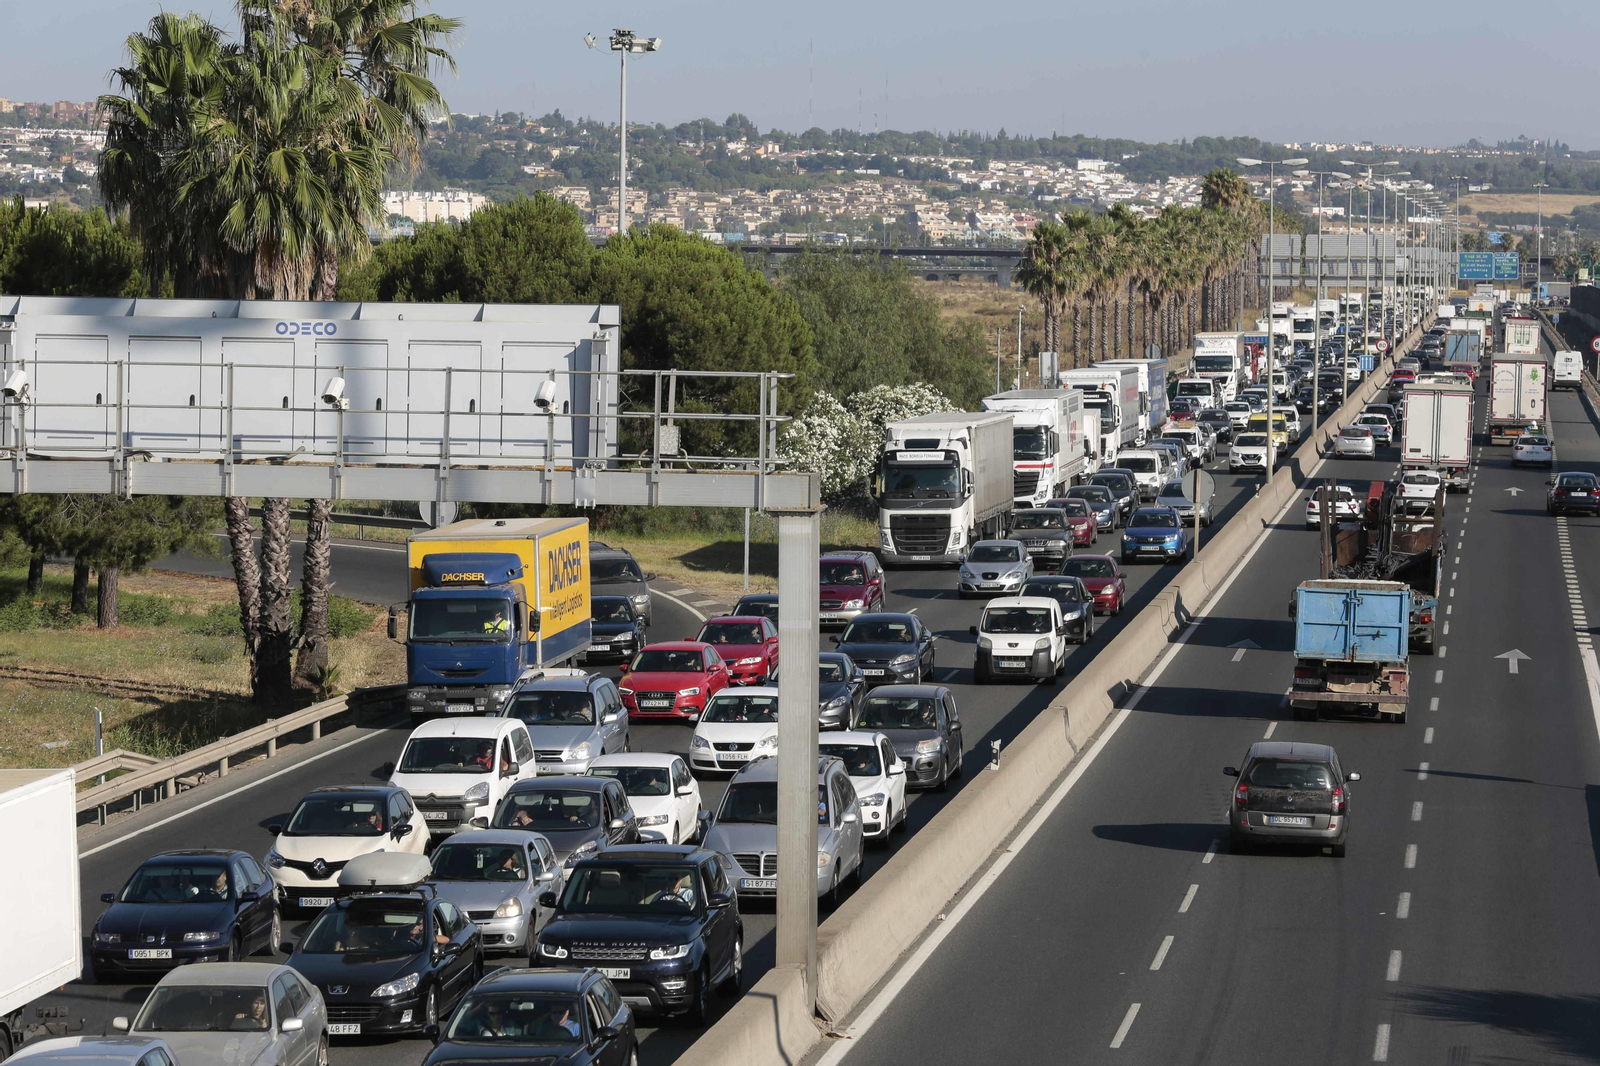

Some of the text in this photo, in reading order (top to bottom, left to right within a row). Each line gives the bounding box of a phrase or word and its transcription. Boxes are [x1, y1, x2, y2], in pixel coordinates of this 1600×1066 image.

[276, 322, 337, 335] ODECO
[549, 540, 582, 593] DACHSER
[441, 572, 485, 582] DACHSER
[303, 898, 323, 906] 9920
[134, 950, 170, 958] 0951 BPK
[613, 969, 629, 978] JPM
[342, 1024, 359, 1033] FFZ
